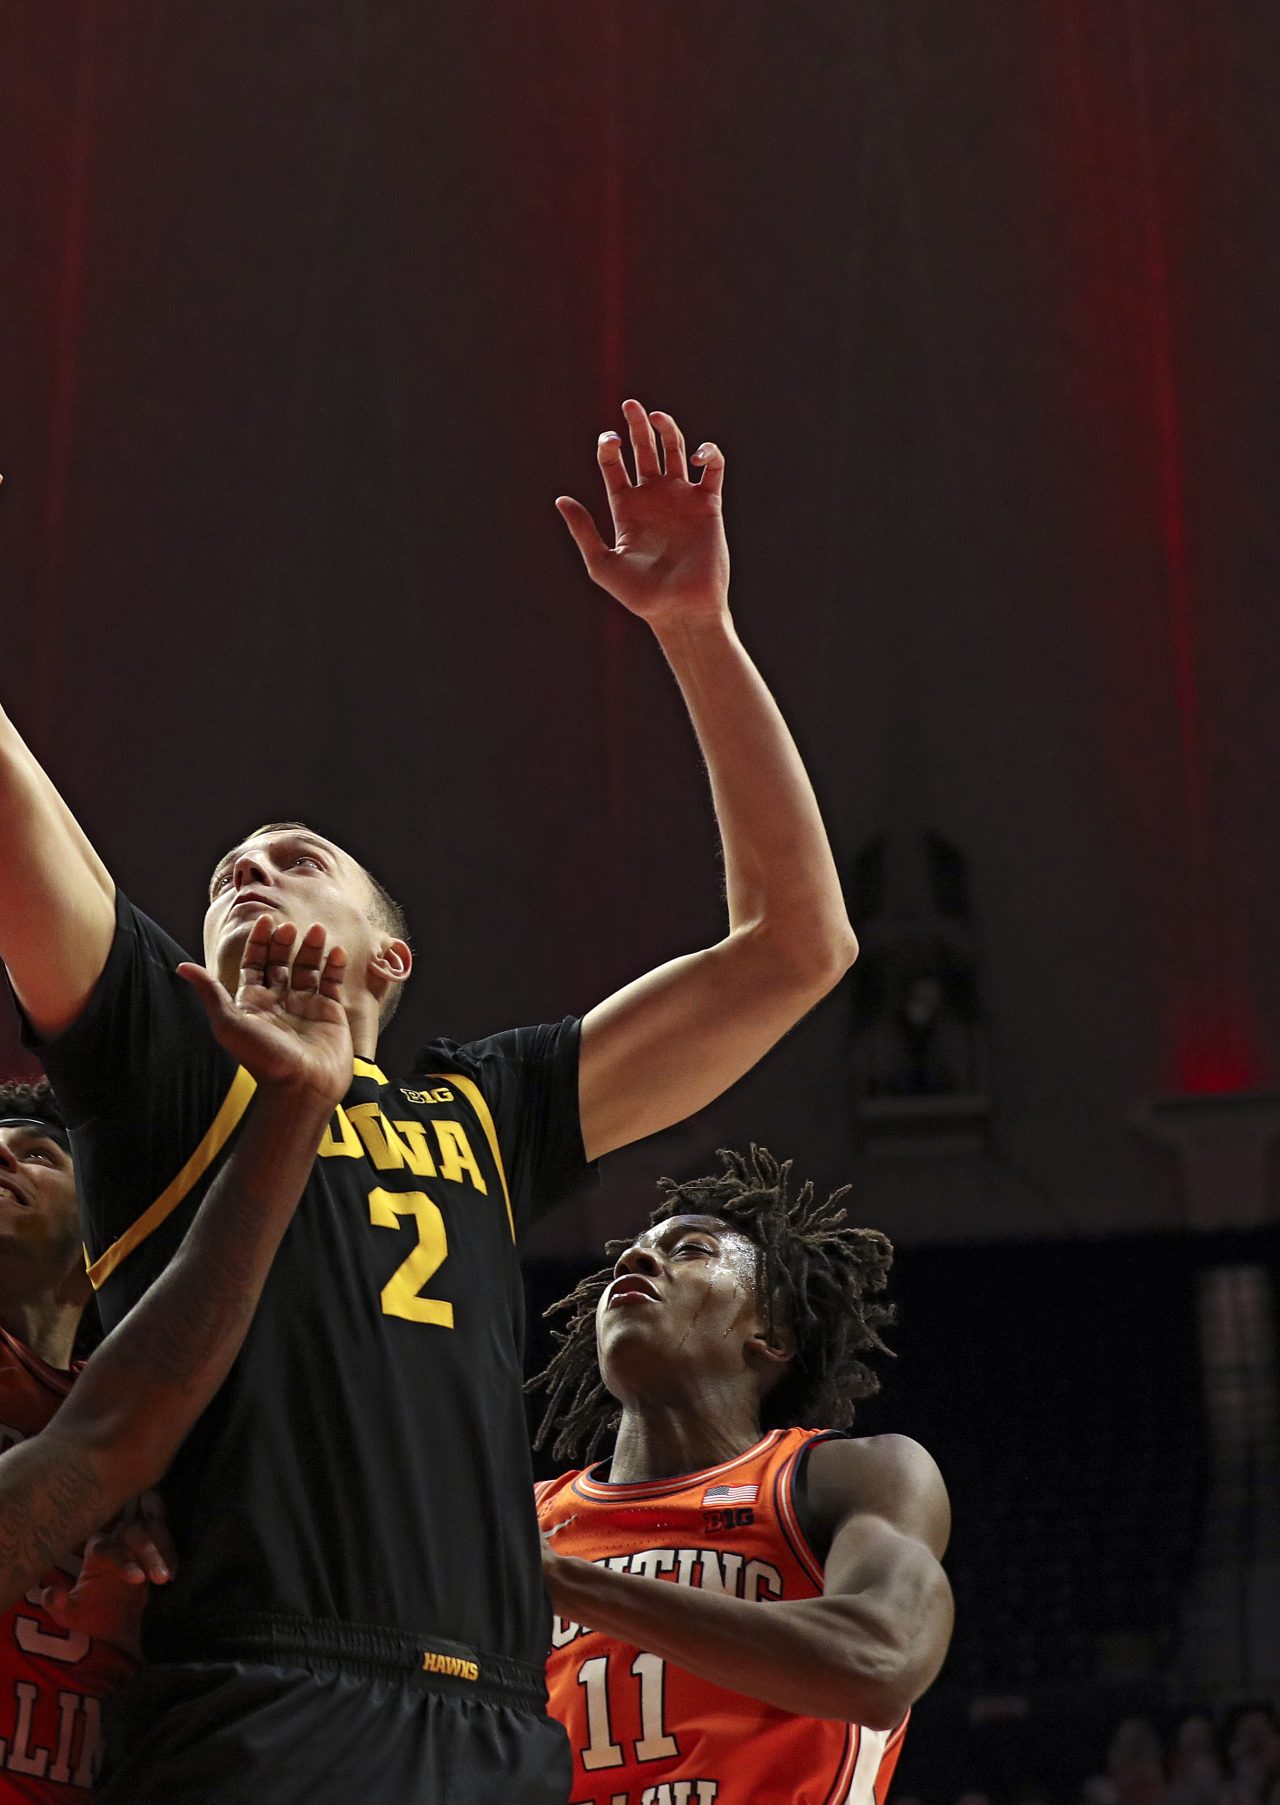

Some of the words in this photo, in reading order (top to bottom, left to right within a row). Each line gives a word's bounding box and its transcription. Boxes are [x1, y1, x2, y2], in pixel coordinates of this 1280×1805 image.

[317, 1102, 488, 1196] OWA
[368, 1186, 455, 1329] 2
[422, 1652, 479, 1681] HAWKS
[578, 1653, 679, 1771] 11
